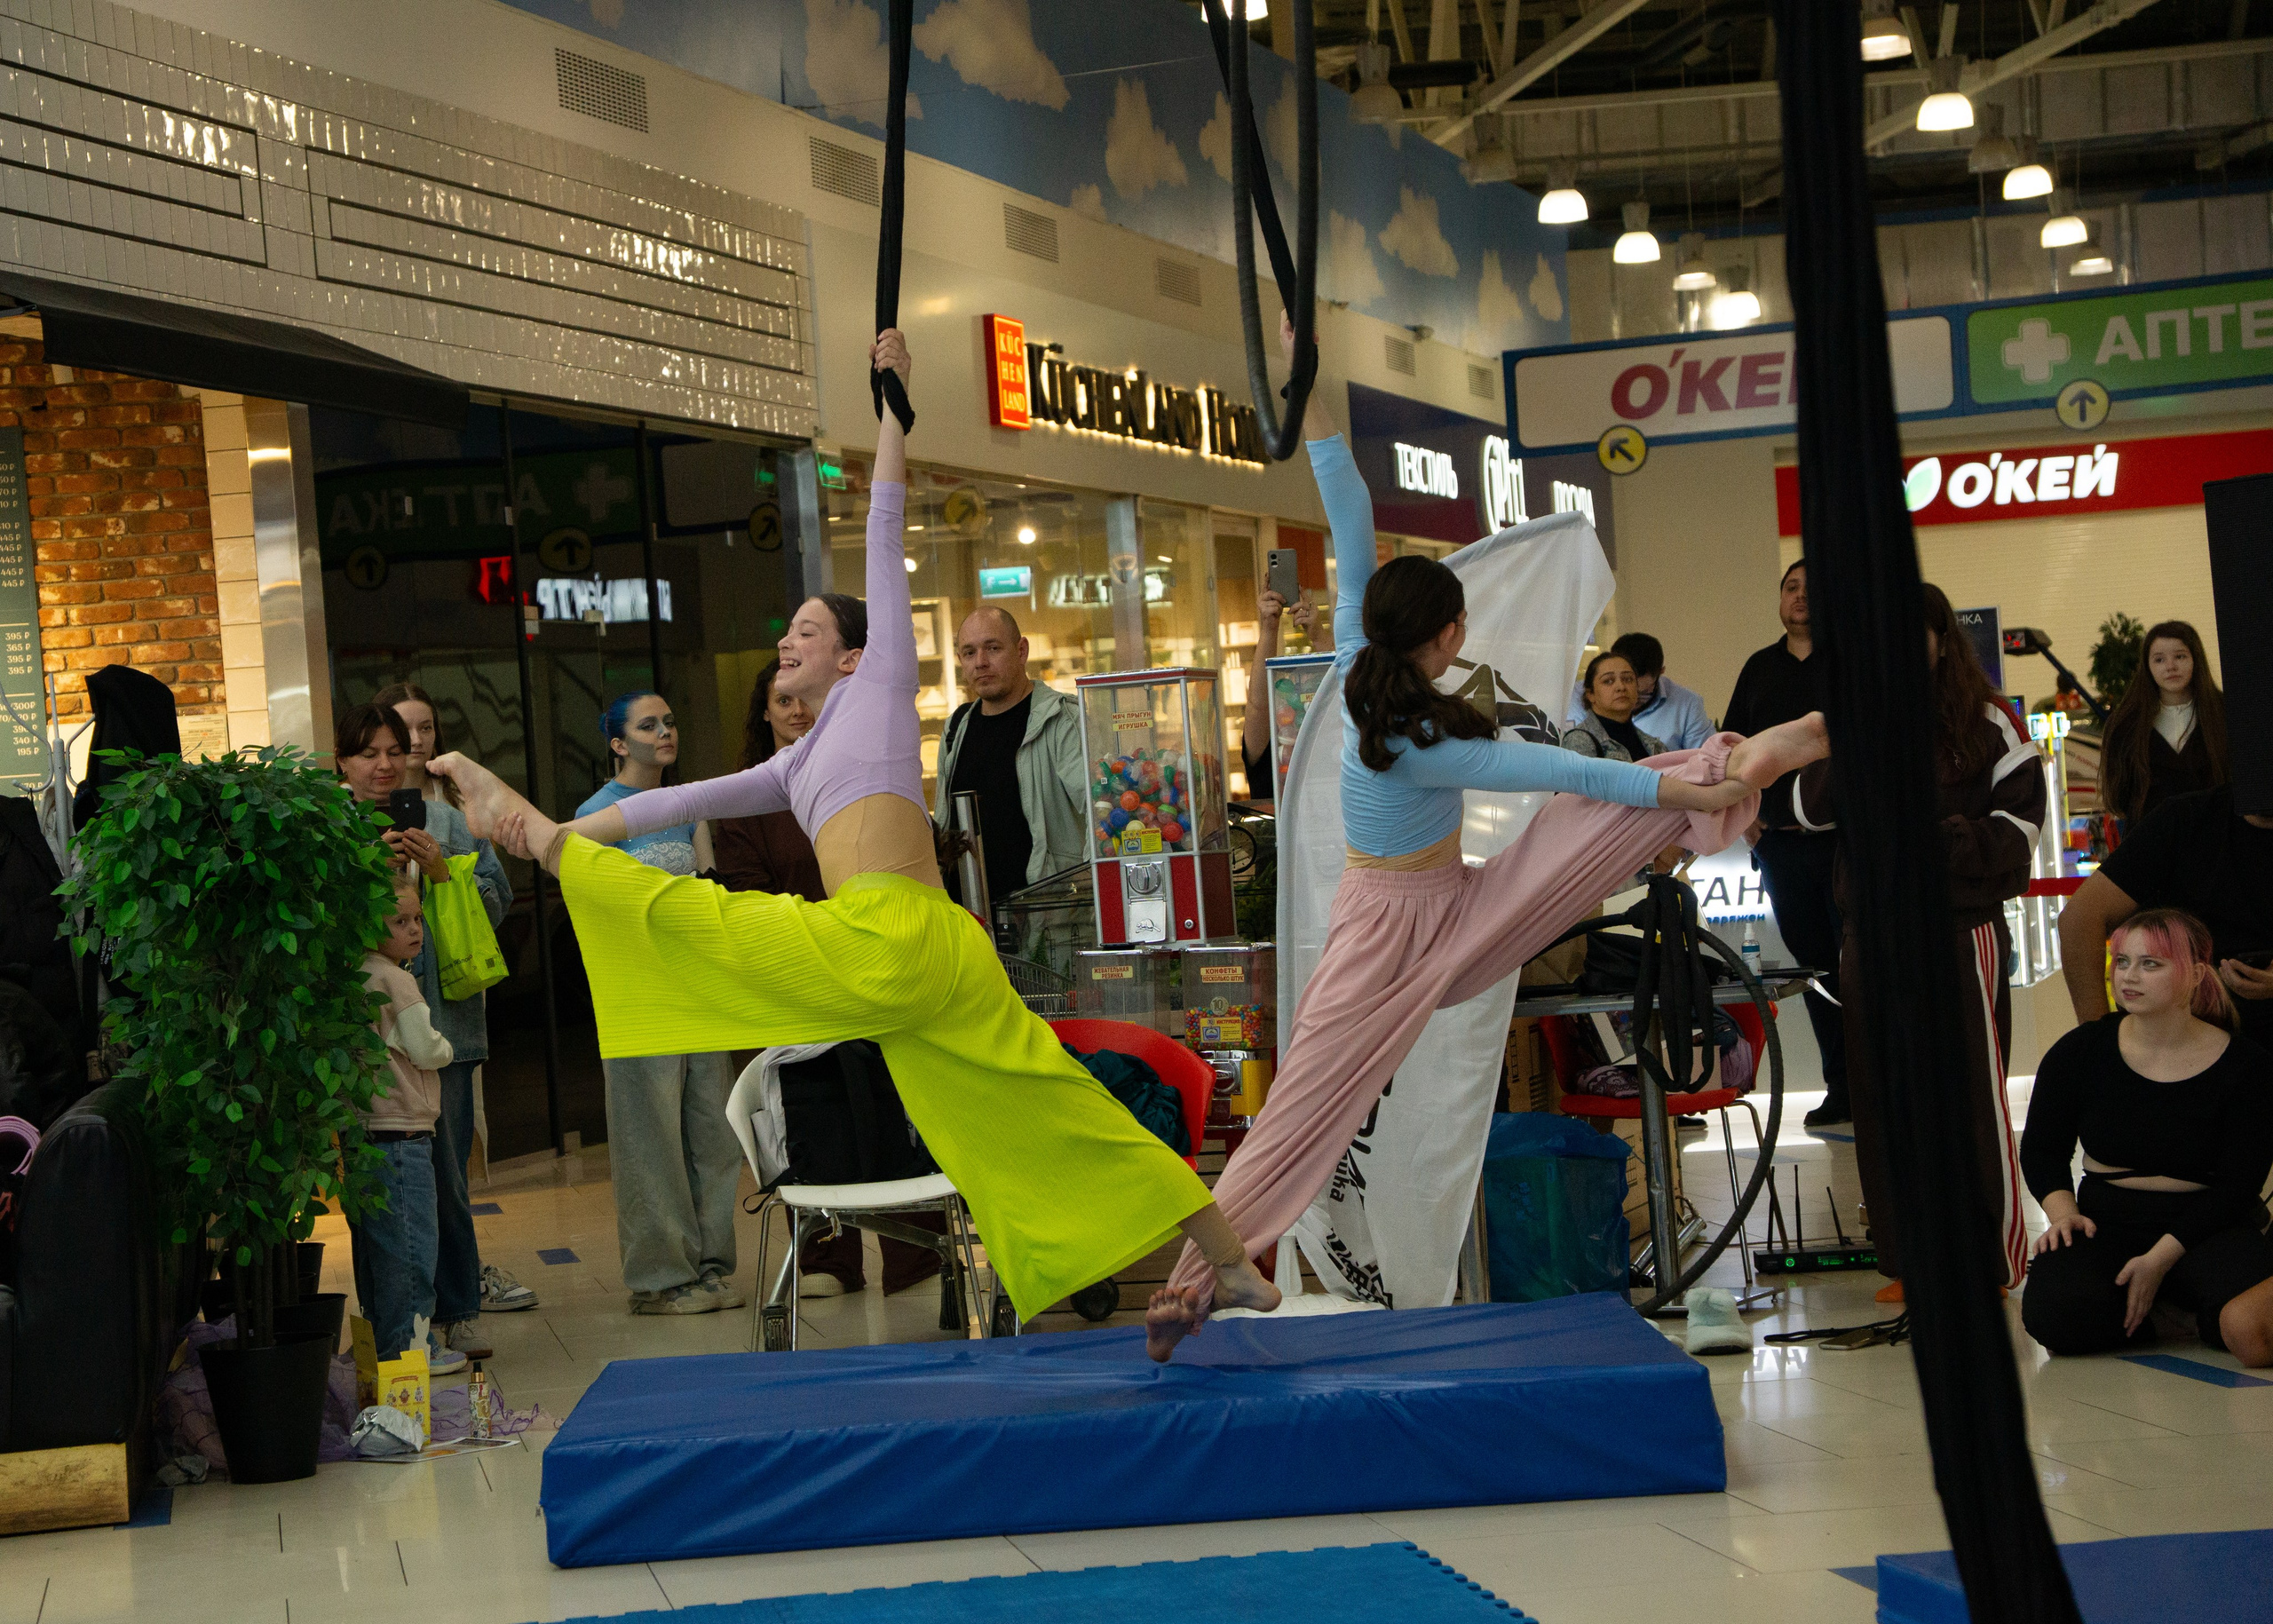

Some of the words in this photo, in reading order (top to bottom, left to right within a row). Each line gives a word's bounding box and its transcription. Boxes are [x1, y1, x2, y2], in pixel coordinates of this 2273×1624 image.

[2095, 299, 2273, 366] АПТЕ
[1002, 360, 1024, 383] HEN
[1611, 348, 1798, 420] О'КЕ
[1003, 389, 1026, 413] LAND
[1394, 442, 1459, 499] ТЕКСТИЛЬ
